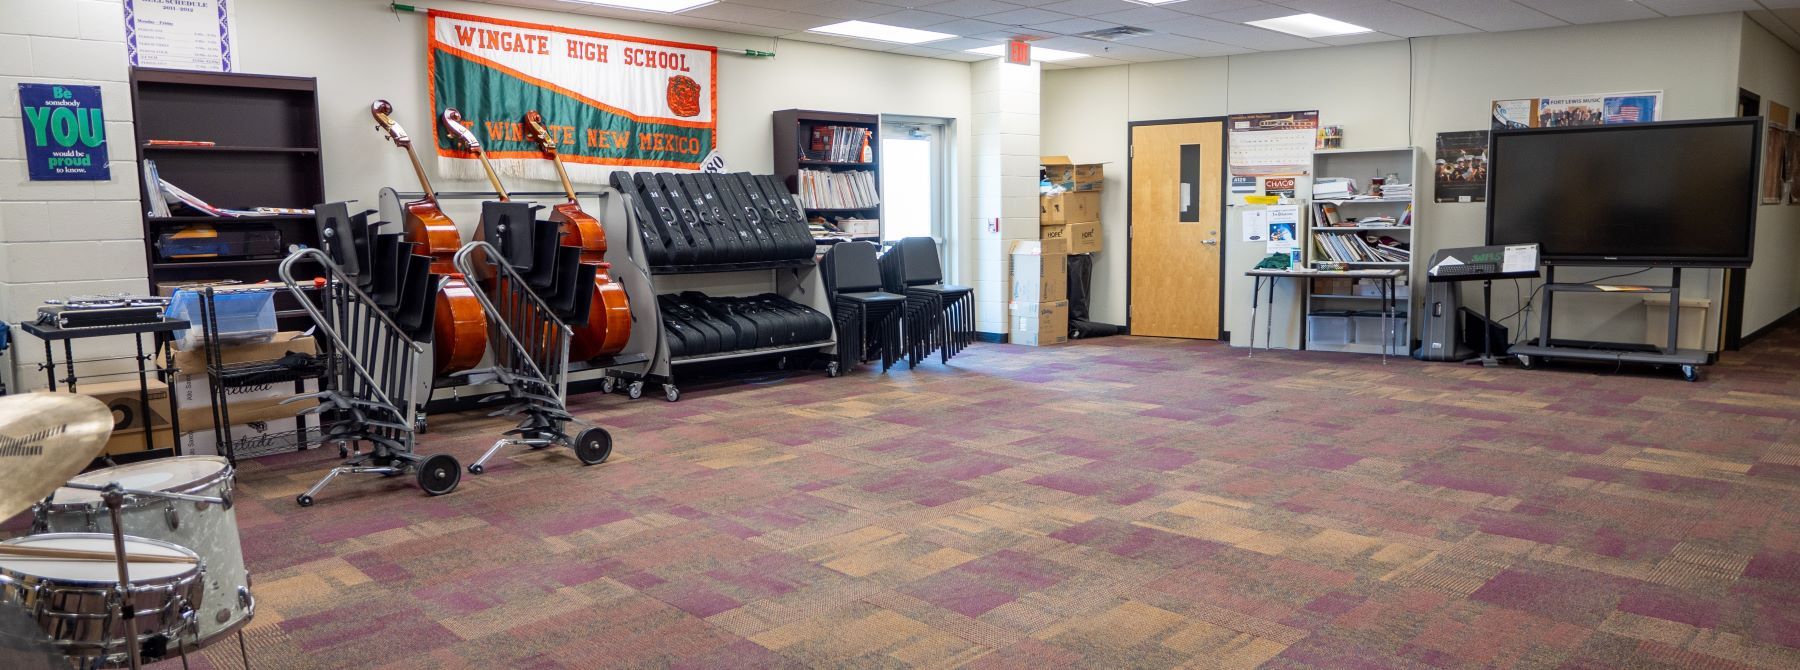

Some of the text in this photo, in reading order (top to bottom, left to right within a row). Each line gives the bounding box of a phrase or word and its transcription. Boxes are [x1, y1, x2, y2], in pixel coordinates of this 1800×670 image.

[165, 0, 208, 8] SCHEDULE
[454, 25, 690, 72] WINGATE HIGH SCHOOL
[52, 86, 73, 99] Be
[24, 106, 104, 147] YOU
[485, 120, 576, 145] WINTE
[587, 129, 630, 149] NEW
[639, 132, 700, 155] MEXICO
[48, 154, 91, 169] proud
[1265, 180, 1294, 188] CHACO
